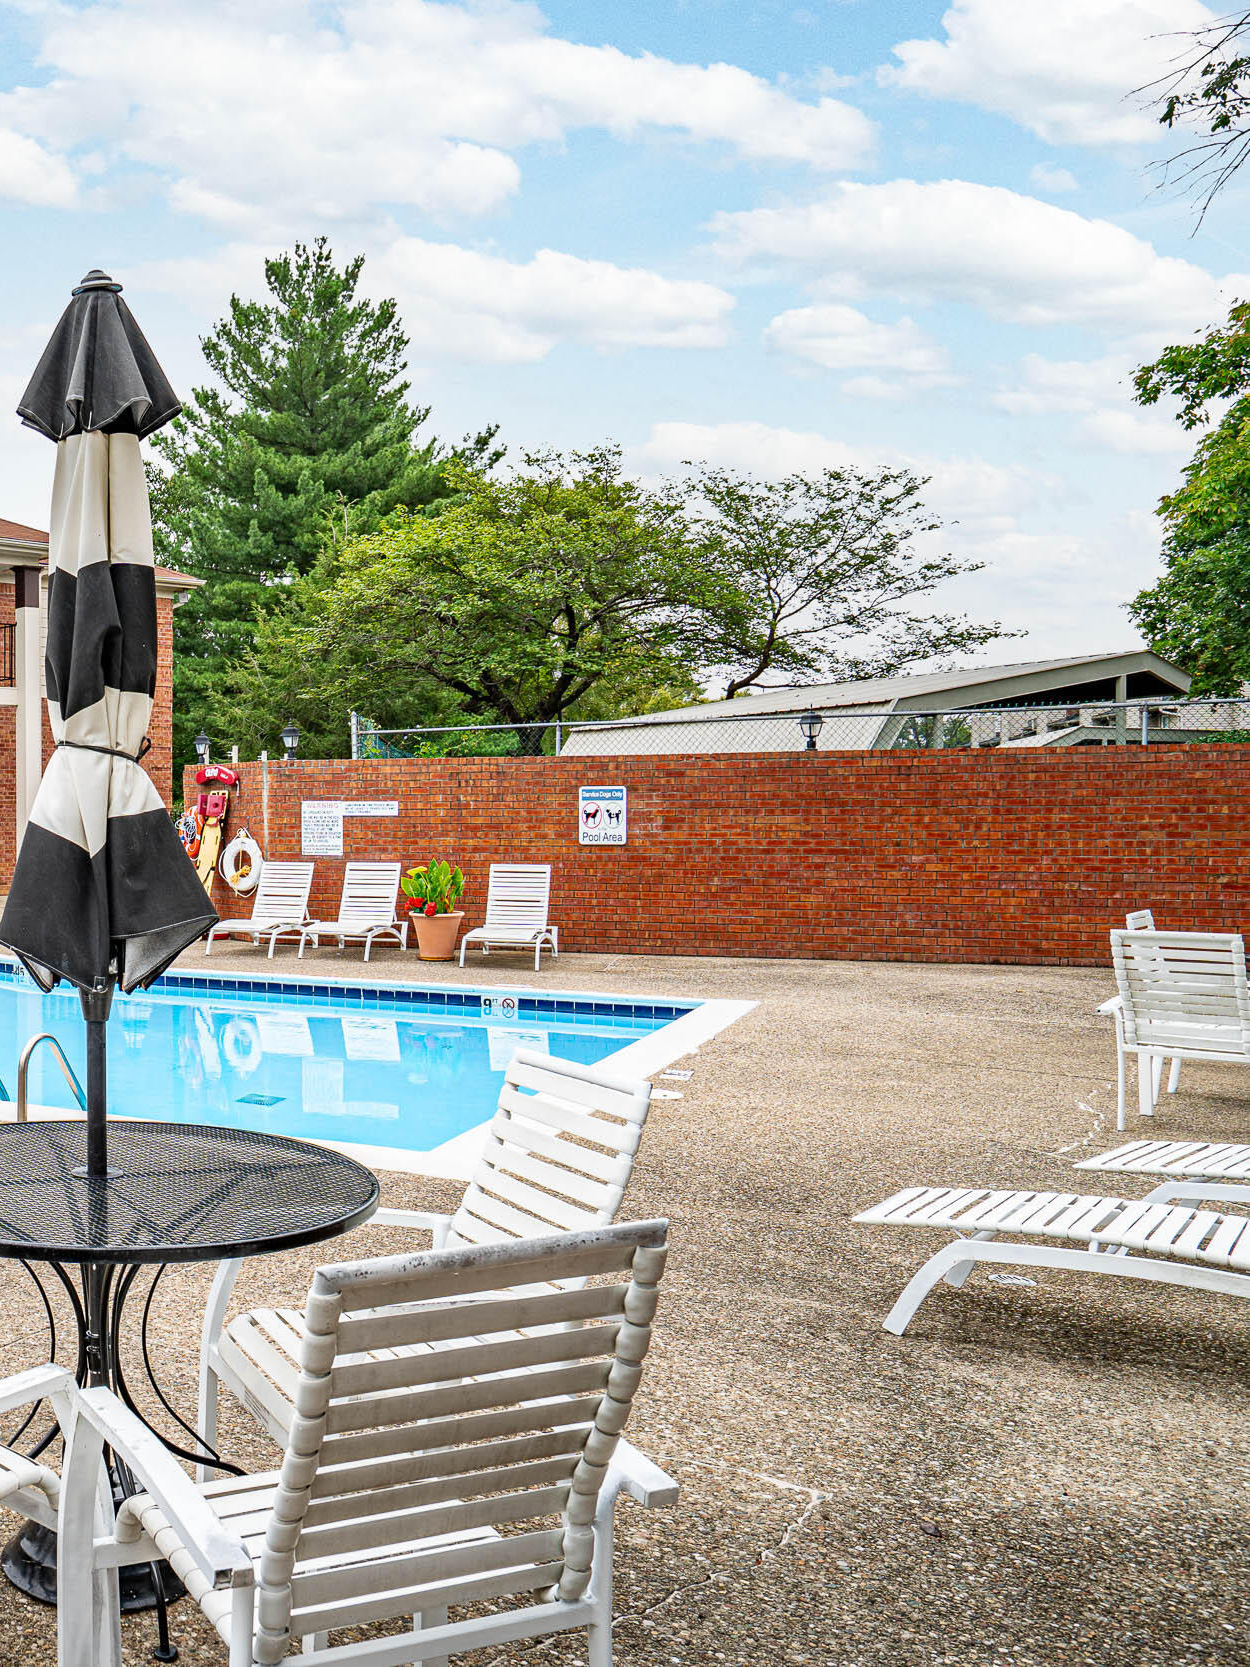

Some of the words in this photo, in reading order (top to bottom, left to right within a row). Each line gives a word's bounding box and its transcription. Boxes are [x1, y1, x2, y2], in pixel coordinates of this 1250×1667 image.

[599, 791, 611, 799] Dogs
[612, 791, 623, 799] Only
[582, 832, 601, 842] Pool
[603, 832, 623, 842] Area
